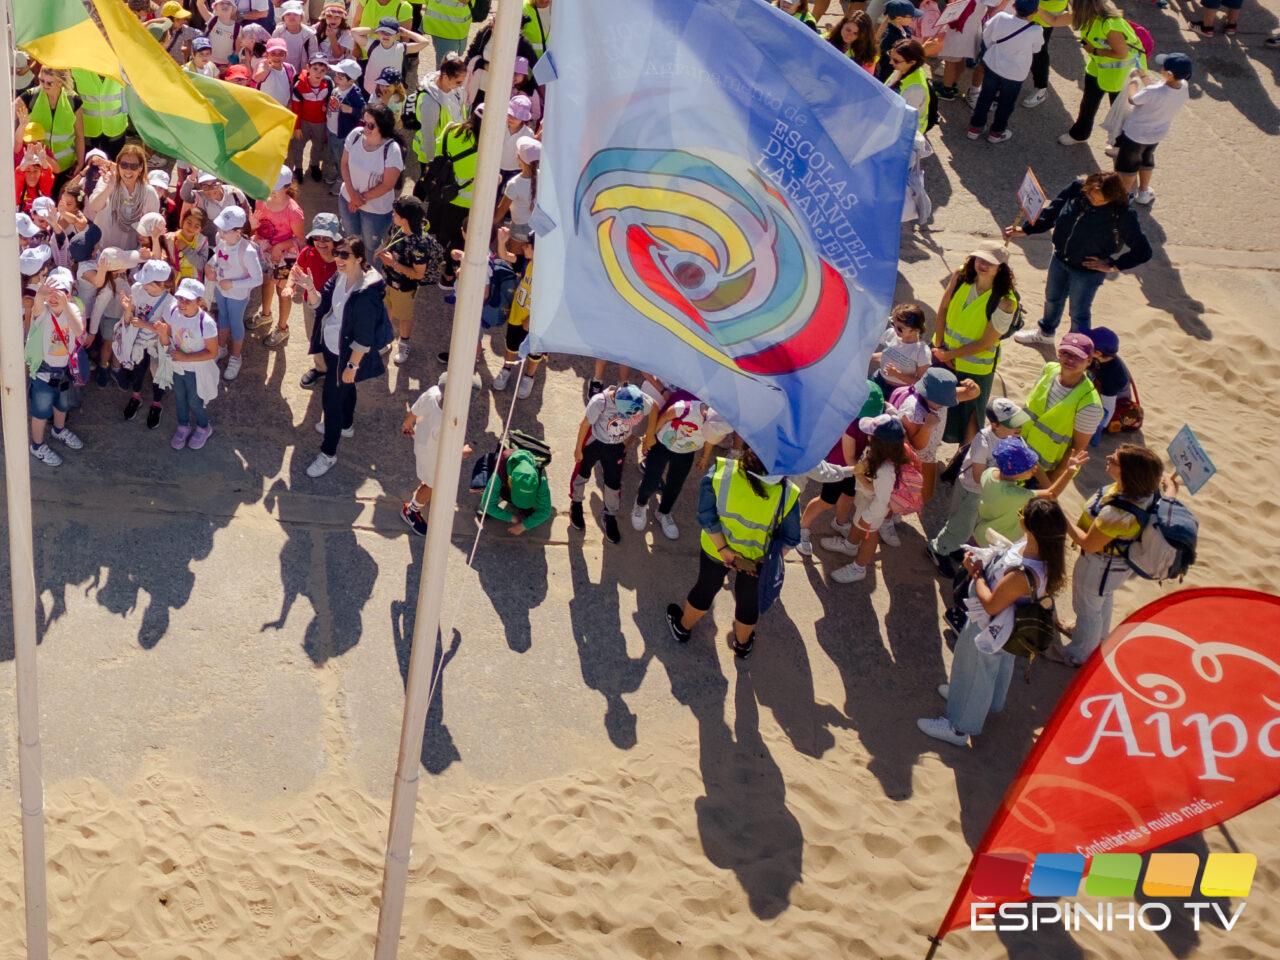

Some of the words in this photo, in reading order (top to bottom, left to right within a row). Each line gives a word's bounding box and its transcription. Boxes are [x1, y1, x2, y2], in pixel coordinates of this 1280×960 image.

[755, 153, 859, 280] LARANJEIR
[762, 135, 796, 174] DR.
[801, 169, 874, 270] MANUEL
[770, 118, 859, 210] ESCOLAS
[1075, 828, 1142, 859] Confeitarias
[1139, 825, 1151, 836] e
[1148, 811, 1184, 832] muito
